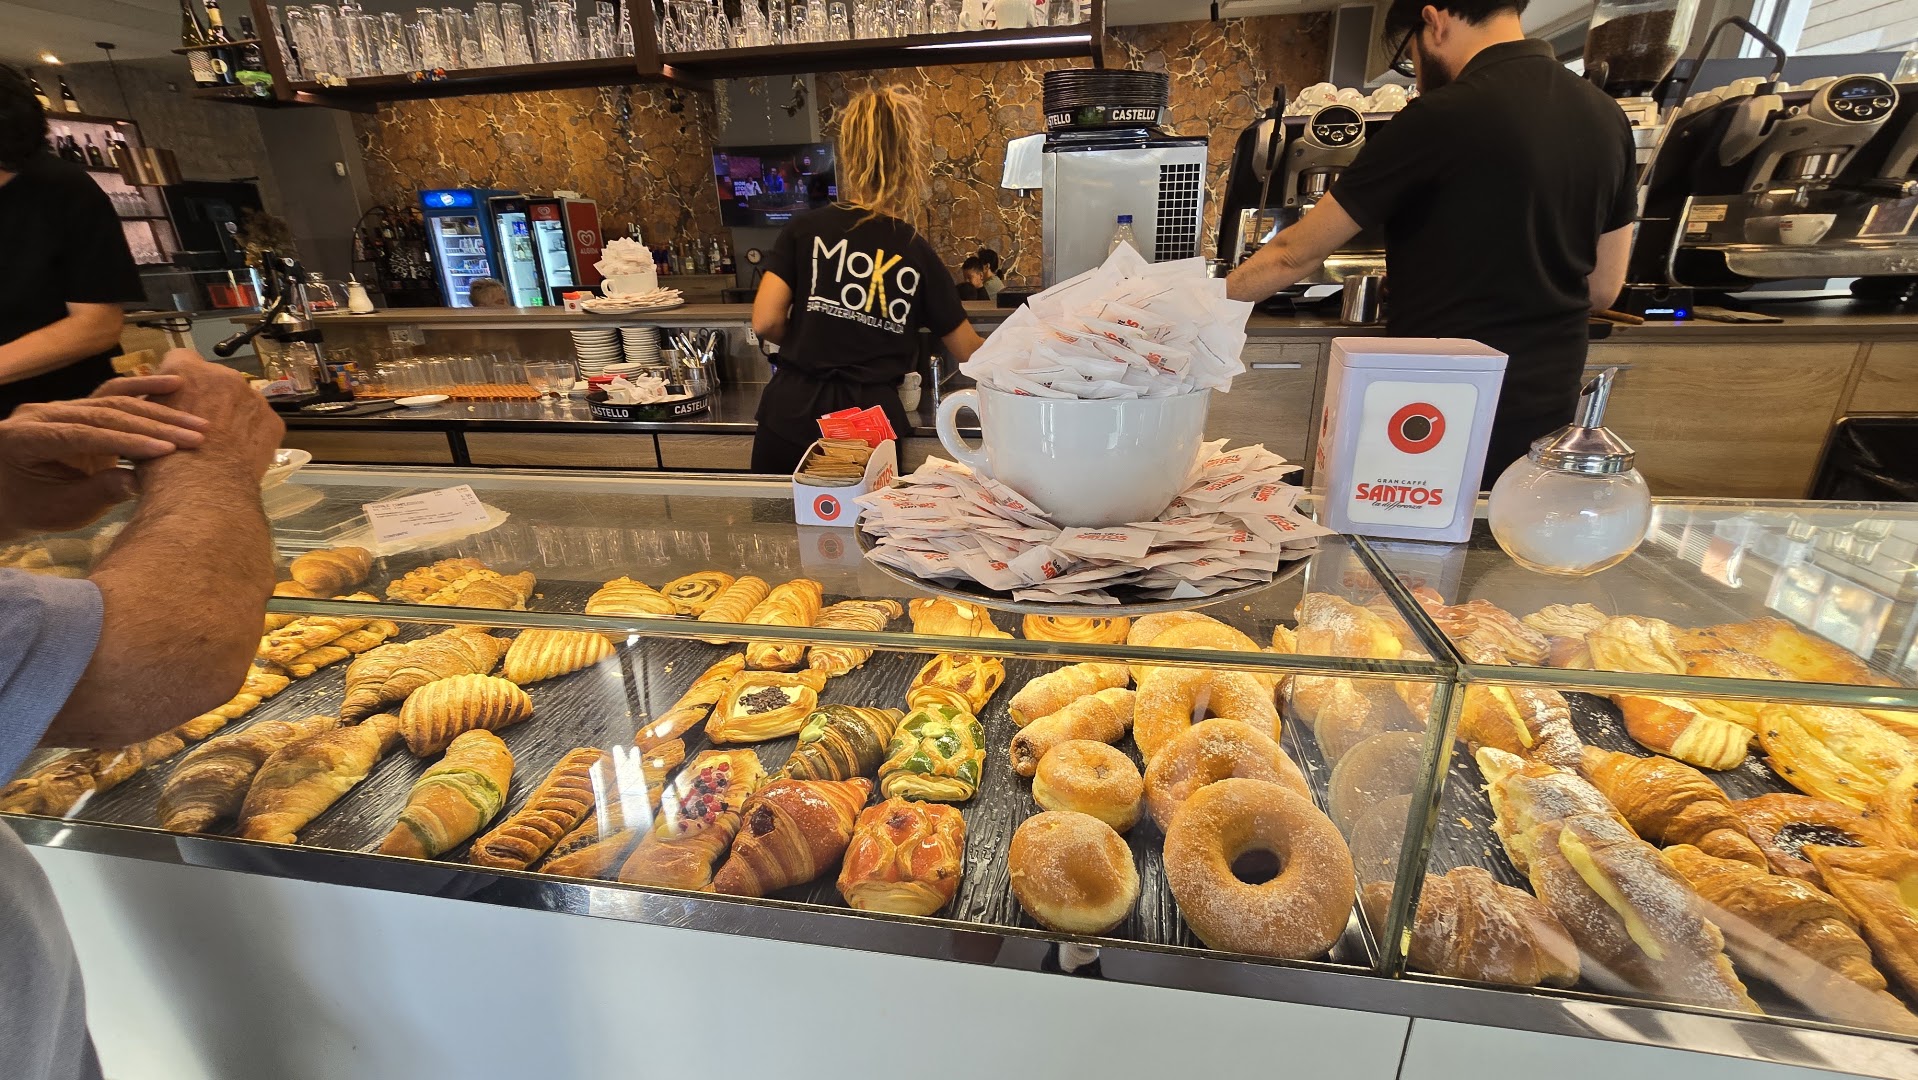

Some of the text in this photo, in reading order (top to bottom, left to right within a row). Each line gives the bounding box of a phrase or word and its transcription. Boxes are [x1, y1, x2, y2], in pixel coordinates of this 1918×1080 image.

[1048, 113, 1071, 126] STELLO
[1112, 109, 1155, 120] CASTELLO
[591, 405, 629, 418] CASTELLO
[1355, 483, 1444, 506] SANTOS
[1040, 560, 1057, 580] SAN
